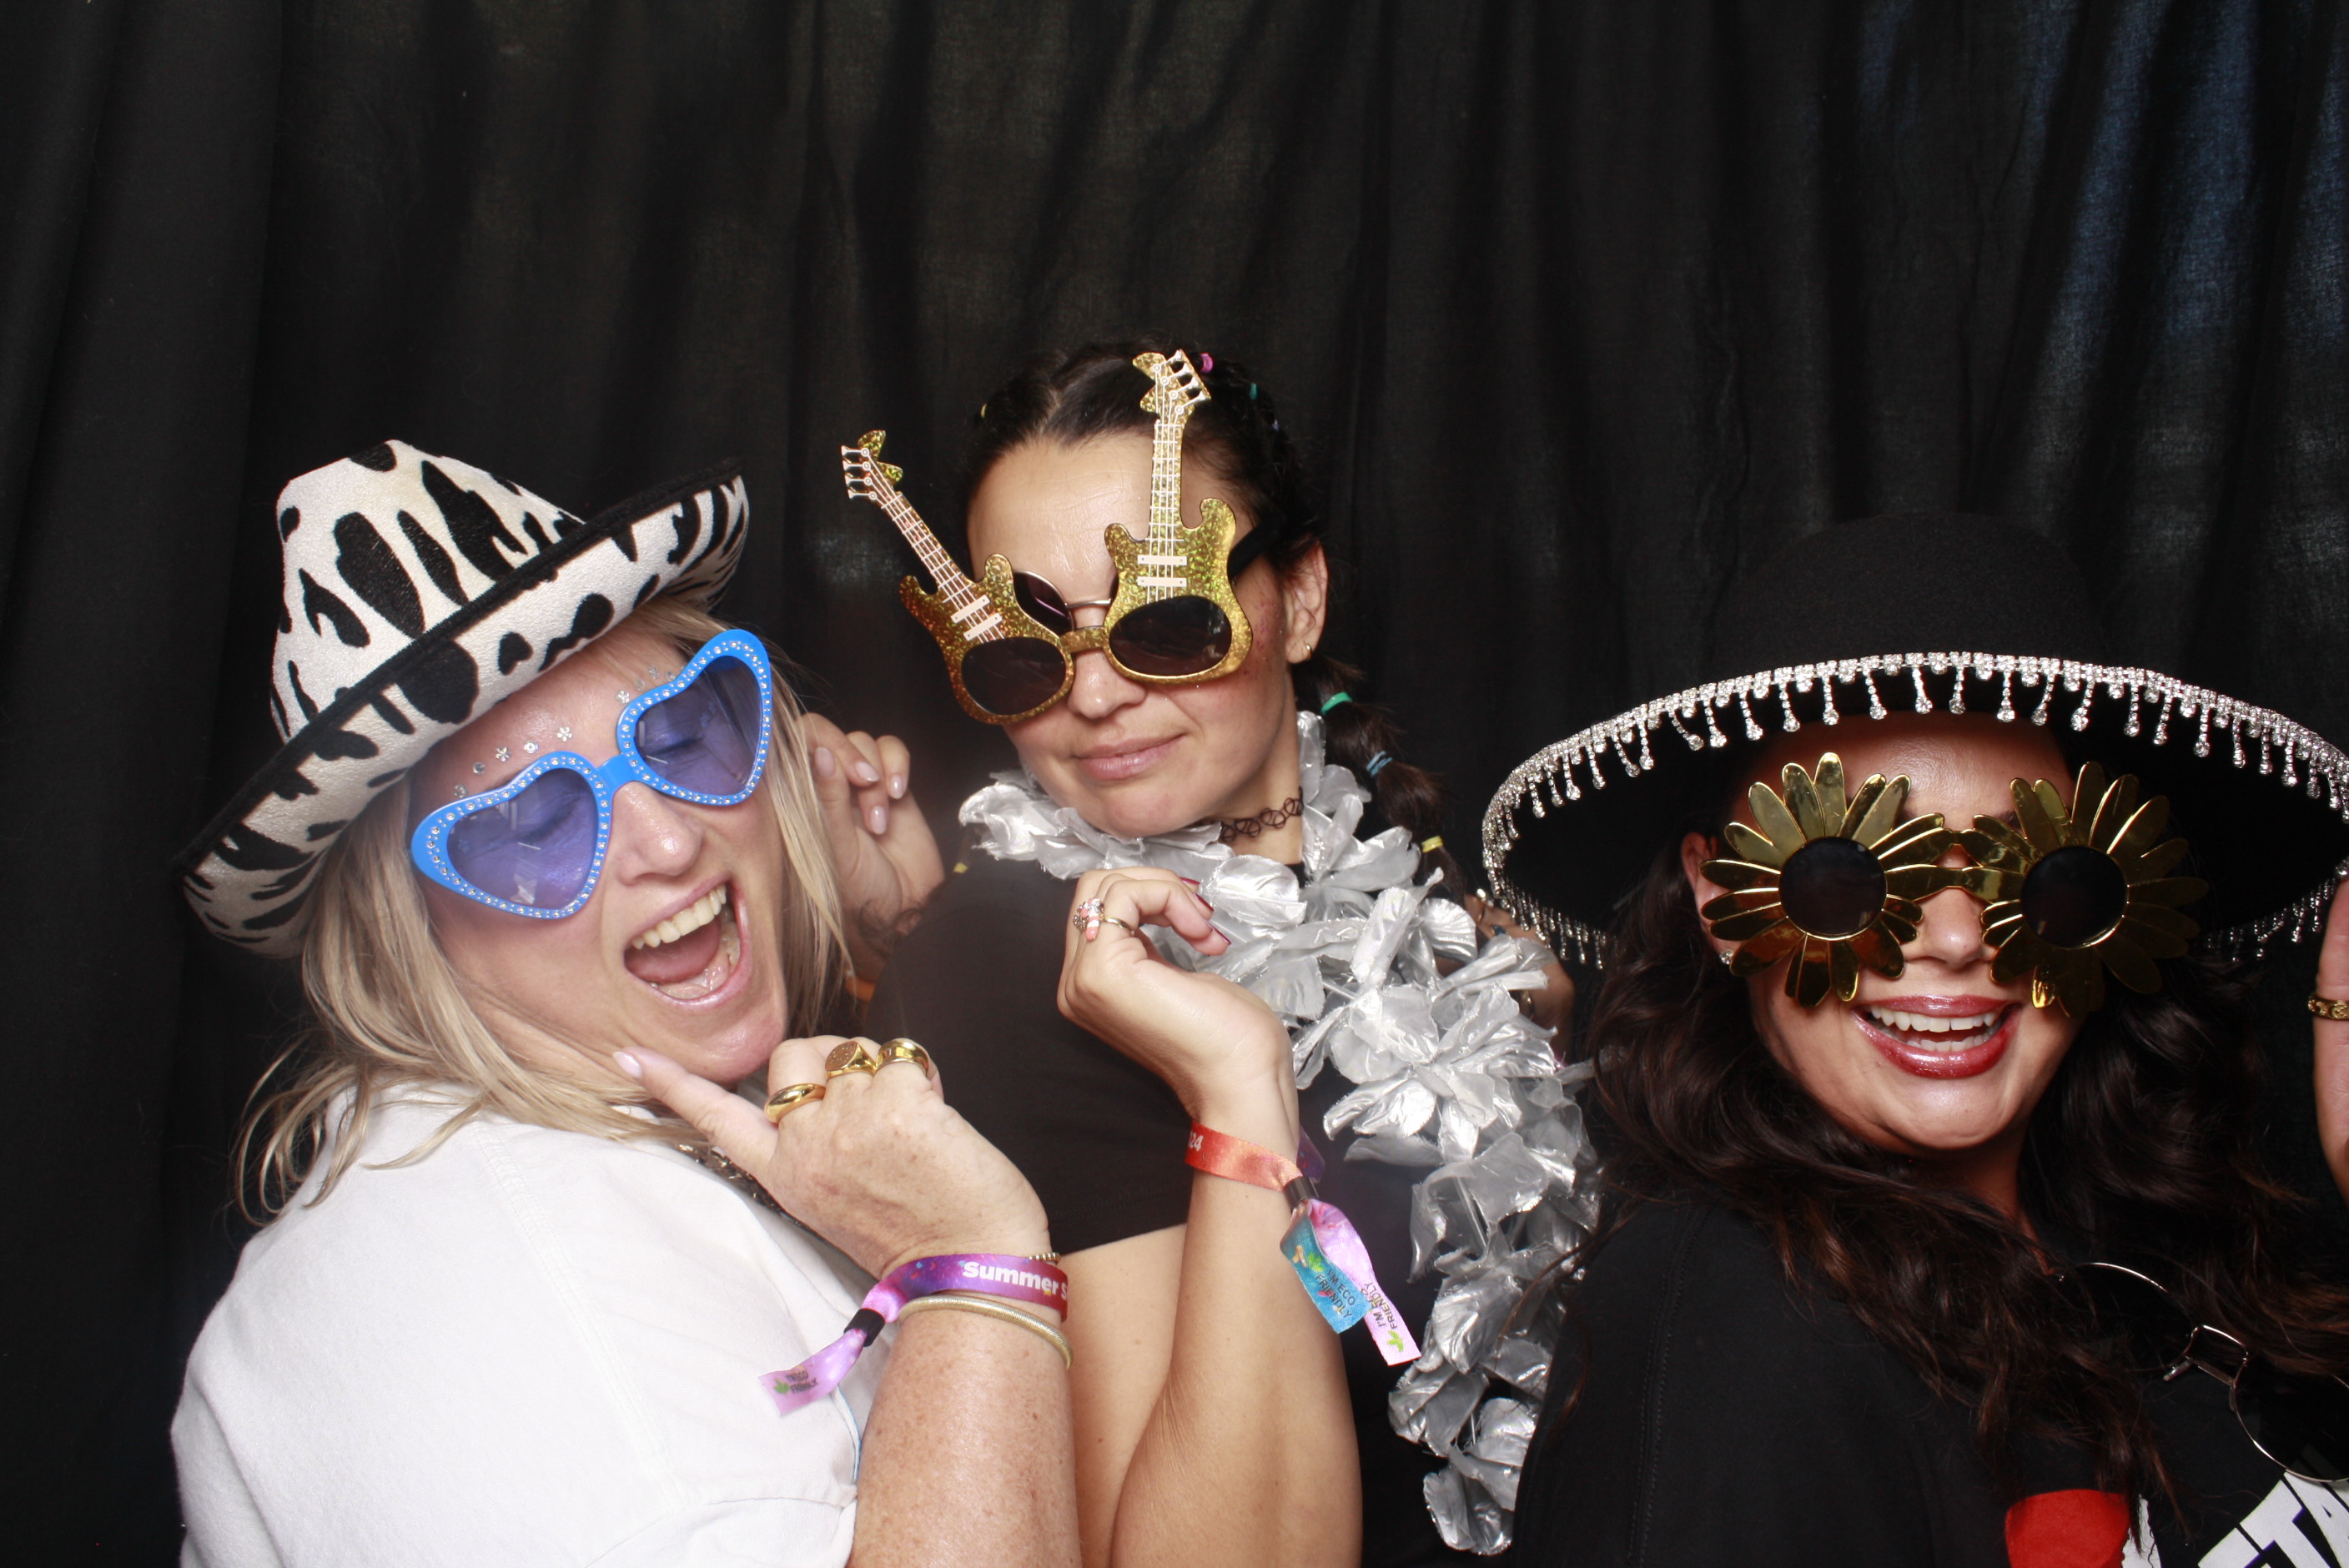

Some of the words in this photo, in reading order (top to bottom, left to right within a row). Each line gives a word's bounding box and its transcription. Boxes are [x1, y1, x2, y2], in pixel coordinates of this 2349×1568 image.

[962, 1261, 1059, 1294] Summer
[1315, 1274, 1352, 1318] FRIENDLY
[1337, 1284, 1356, 1305] ECO
[1364, 1282, 1398, 1329] FRIENDLY
[1373, 1312, 1386, 1327] I'M
